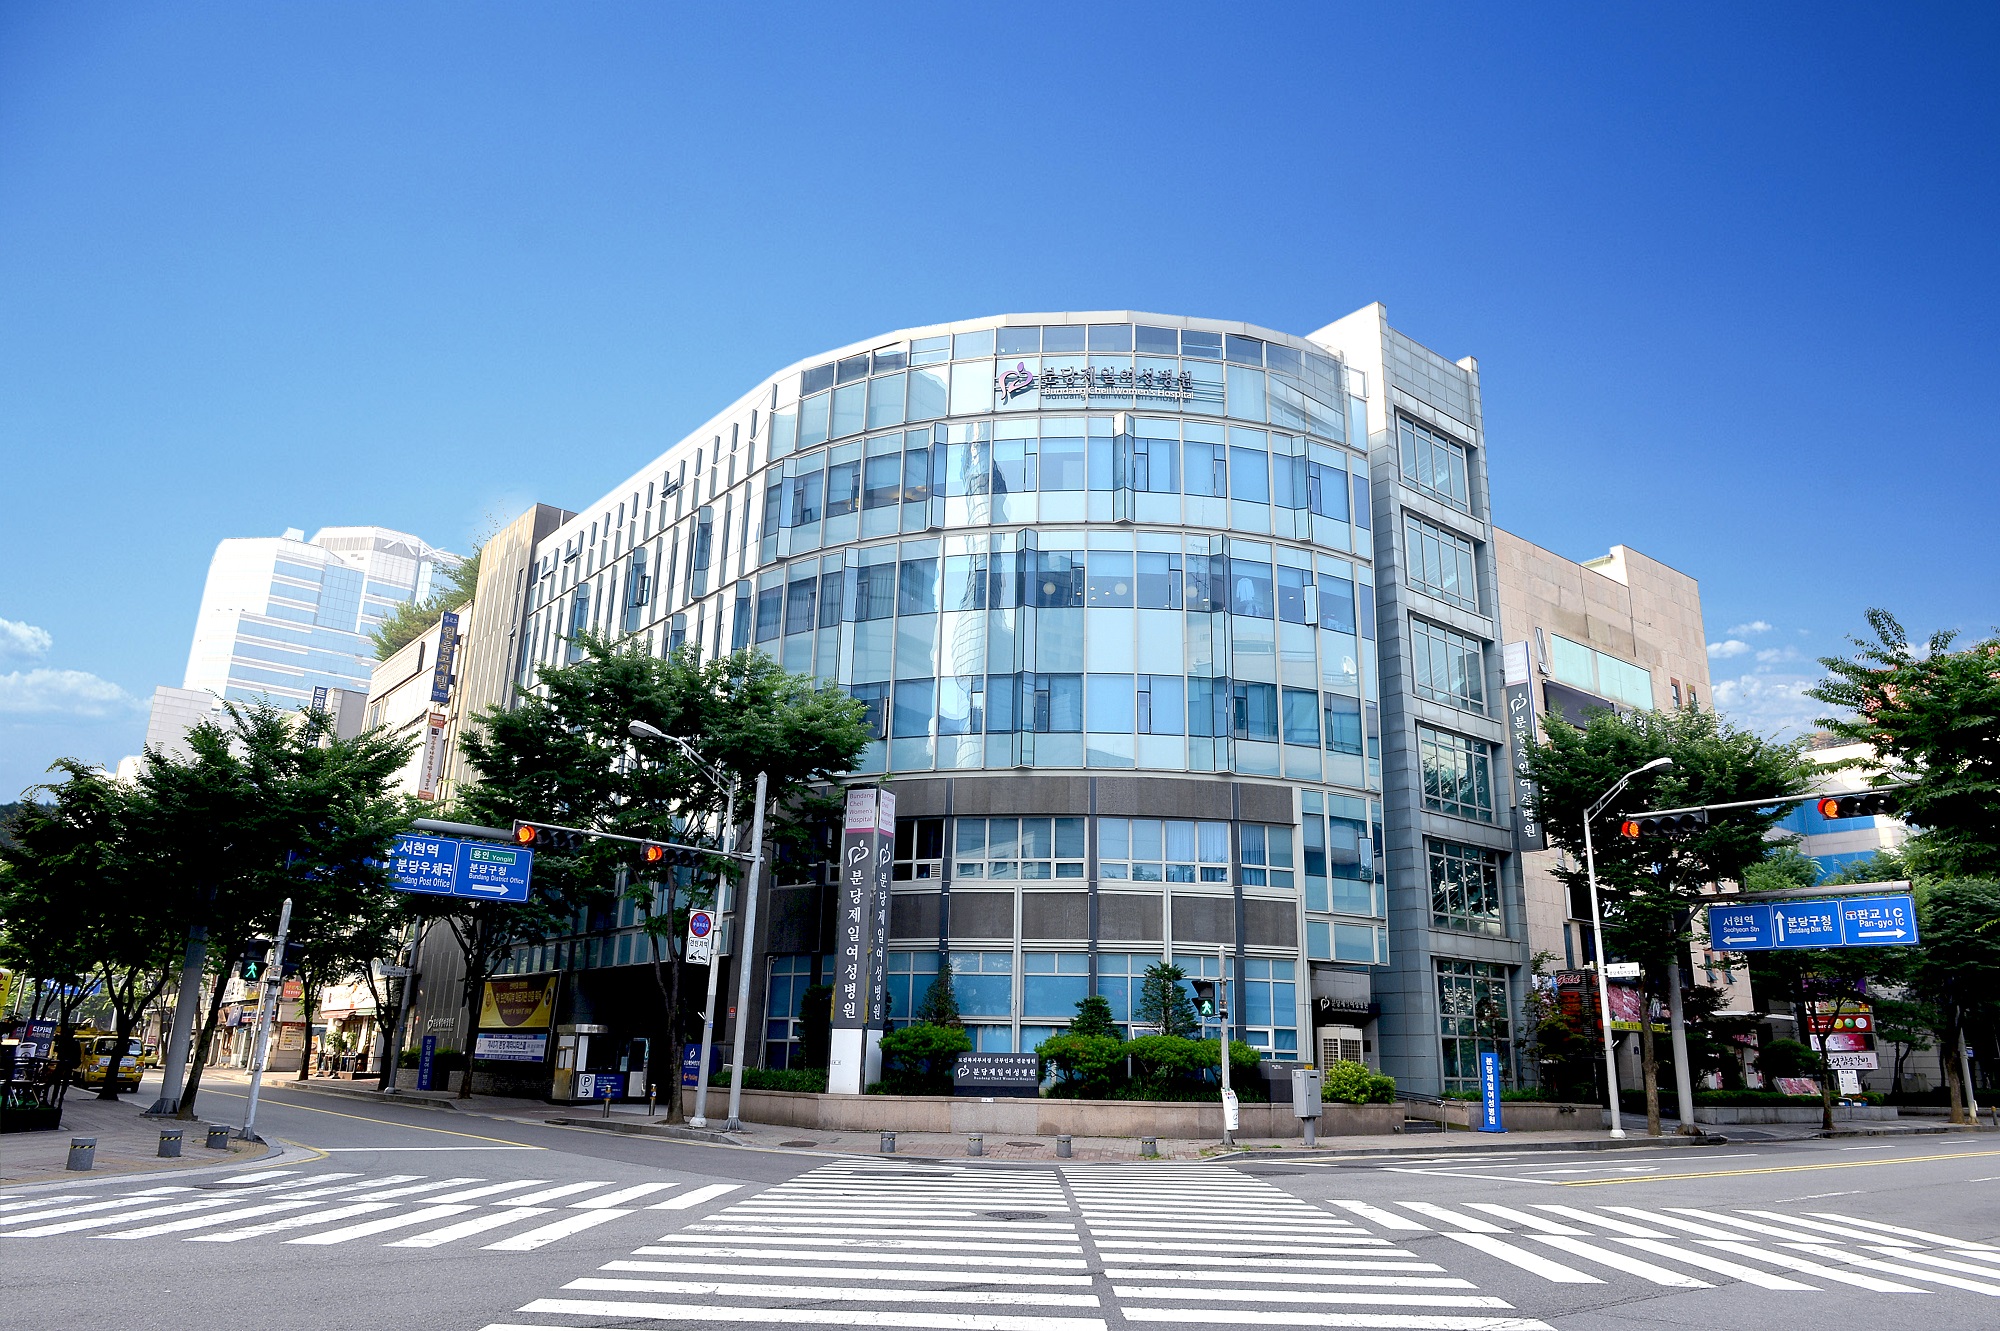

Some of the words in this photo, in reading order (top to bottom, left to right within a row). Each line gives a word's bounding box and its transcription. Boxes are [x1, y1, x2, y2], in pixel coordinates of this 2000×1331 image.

[1043, 365, 1193, 389] 분당제일여성병원
[1045, 386, 1086, 396] Bundang
[1088, 386, 1112, 395] Cheil
[1113, 387, 1155, 396] Women's
[1157, 389, 1194, 400] Hospital
[848, 816, 873, 824] Hospital
[399, 841, 439, 858] 서현역
[473, 850, 490, 860] 용인
[492, 854, 513, 863] Yongin
[396, 859, 453, 878] 분당우체국
[469, 863, 507, 876] 분당구청
[419, 876, 433, 888] Post
[434, 877, 451, 888] Office
[468, 872, 490, 882] Bundang
[491, 874, 509, 883] District
[510, 876, 525, 885] Office
[1723, 915, 1754, 926] 서현역
[1857, 909, 1881, 920] 판교
[1787, 915, 1832, 927] 분당구청
[1859, 918, 1893, 929] Pan-gyo
[1895, 918, 1905, 926] IC
[1788, 927, 1810, 935] Bundang
[690, 940, 708, 948] 견인지역
[843, 870, 864, 1019] 분당제일여성병원
[873, 872, 887, 1020] 분당제일여성병원
[1557, 974, 1580, 986] Gold
[33, 1025, 52, 1034] 더카페
[421, 1039, 432, 1086] 분당제일여성병원
[972, 1067, 1036, 1077] 분당제일여성병원
[1486, 1057, 1495, 1124] 분당제일여성병원
